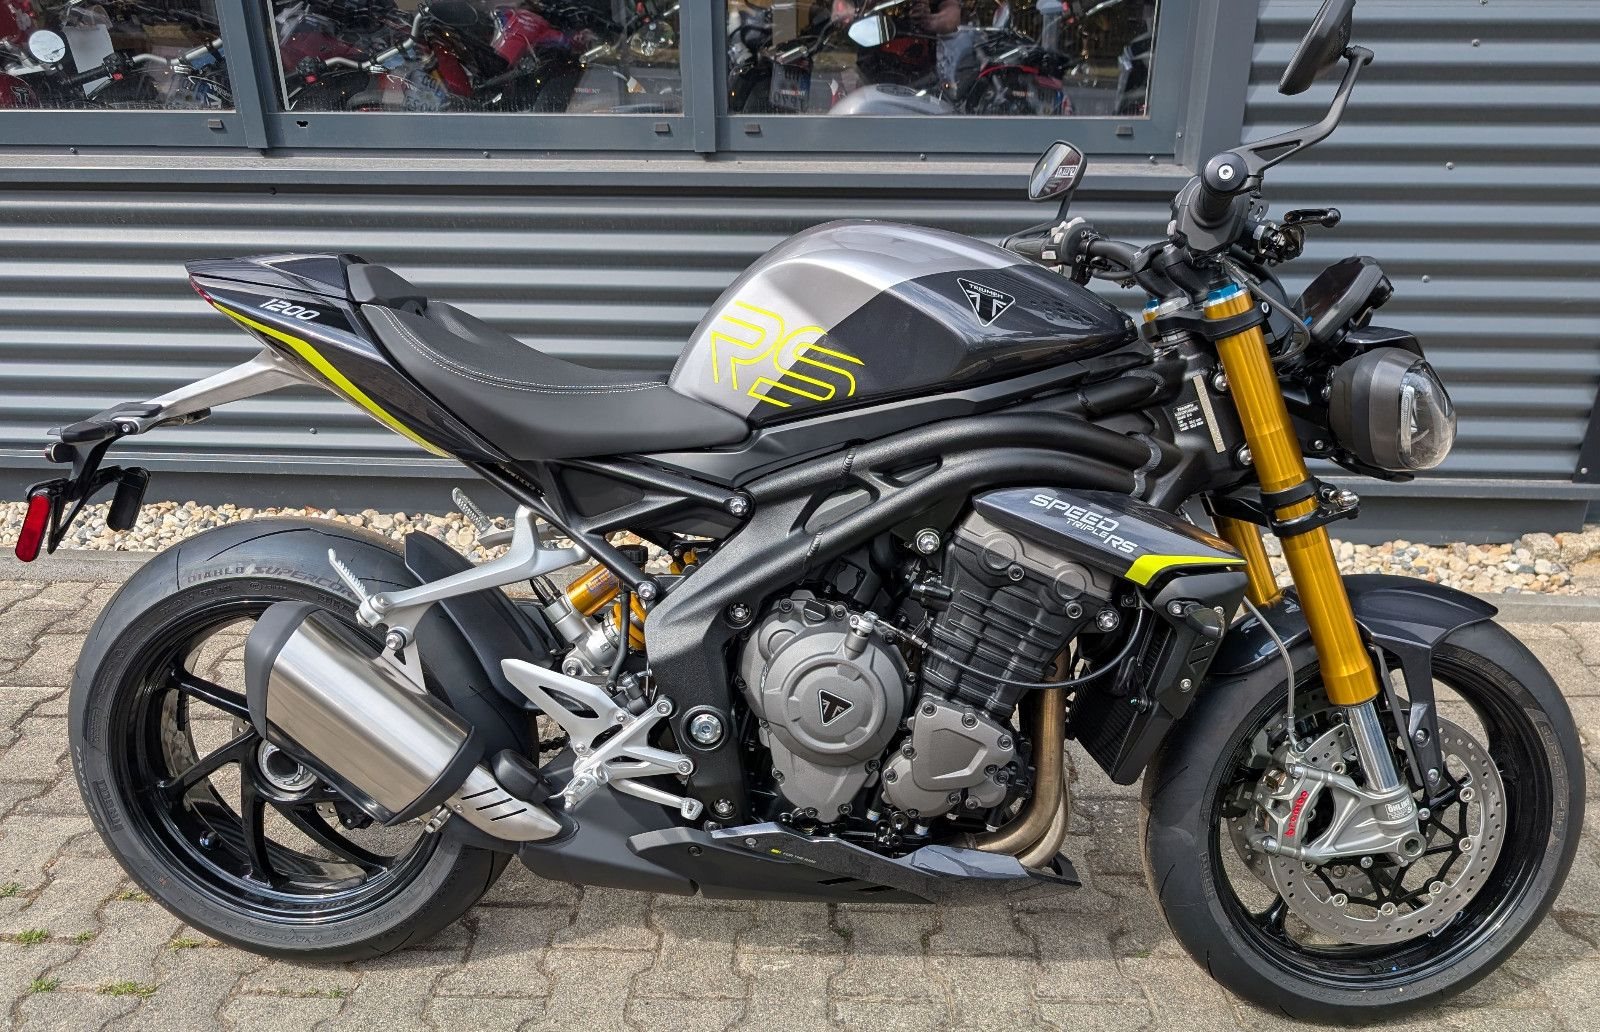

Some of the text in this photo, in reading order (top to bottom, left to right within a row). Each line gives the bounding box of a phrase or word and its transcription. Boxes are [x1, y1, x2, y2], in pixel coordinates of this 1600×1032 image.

[968, 283, 1004, 300] TRIUMPH
[260, 298, 320, 320] 1200
[710, 300, 865, 408] RS
[1029, 493, 1120, 532] SPEED
[1065, 517, 1110, 538] TRIPLE
[1103, 534, 1138, 554] RS
[1284, 790, 1308, 837] brembo
